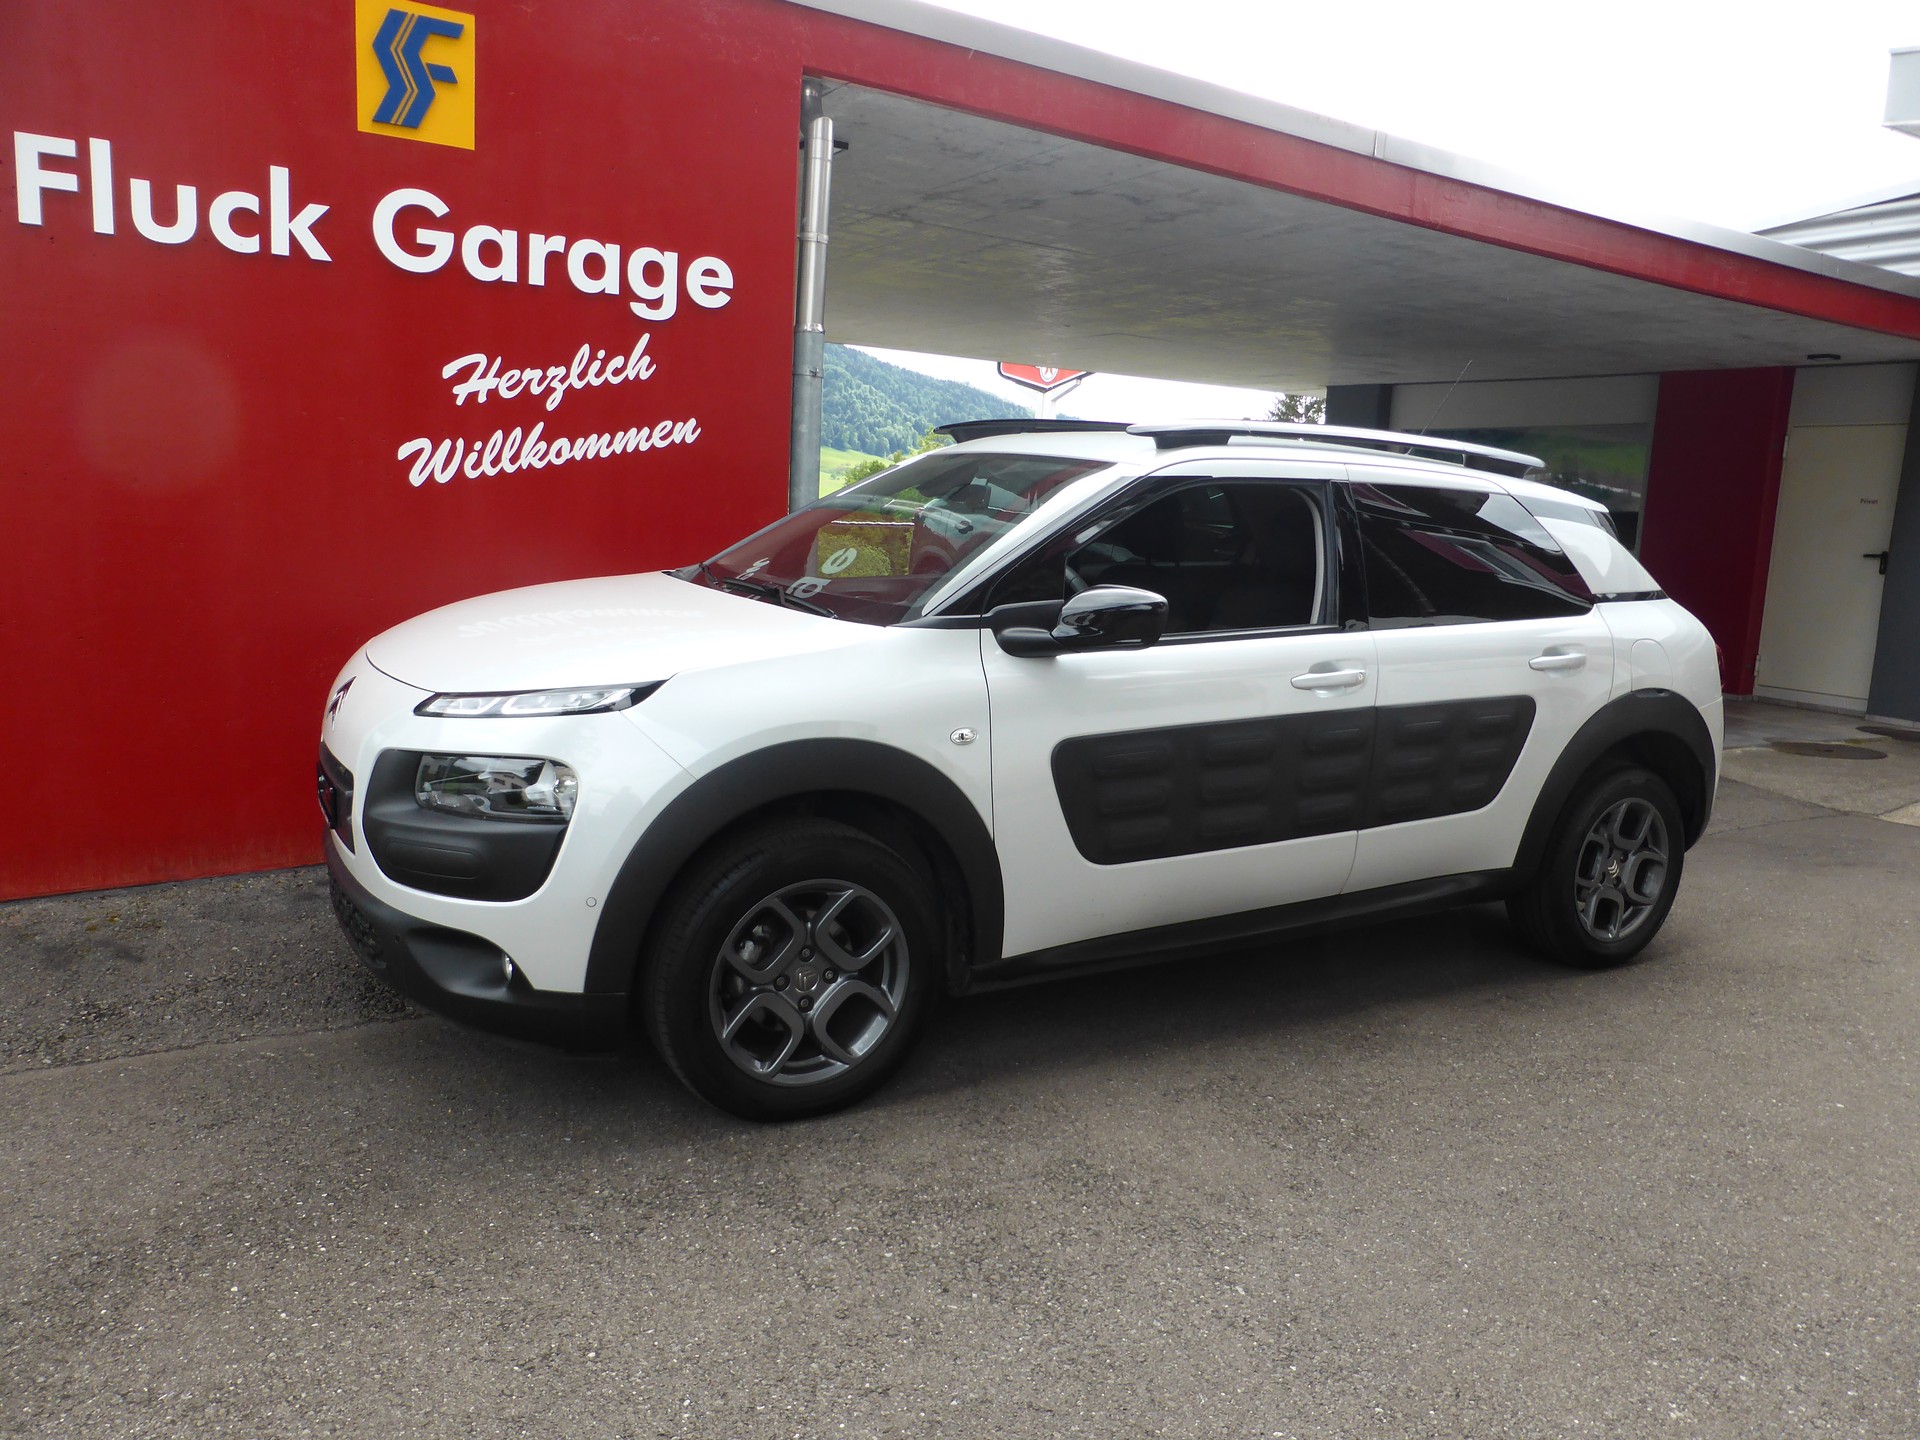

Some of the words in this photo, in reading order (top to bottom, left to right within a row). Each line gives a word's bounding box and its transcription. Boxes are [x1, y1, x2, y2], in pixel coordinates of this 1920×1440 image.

[14, 131, 332, 261] Fluck
[373, 188, 733, 320] Garage
[442, 333, 656, 411] Herzlich
[398, 418, 701, 487] Willkommen
